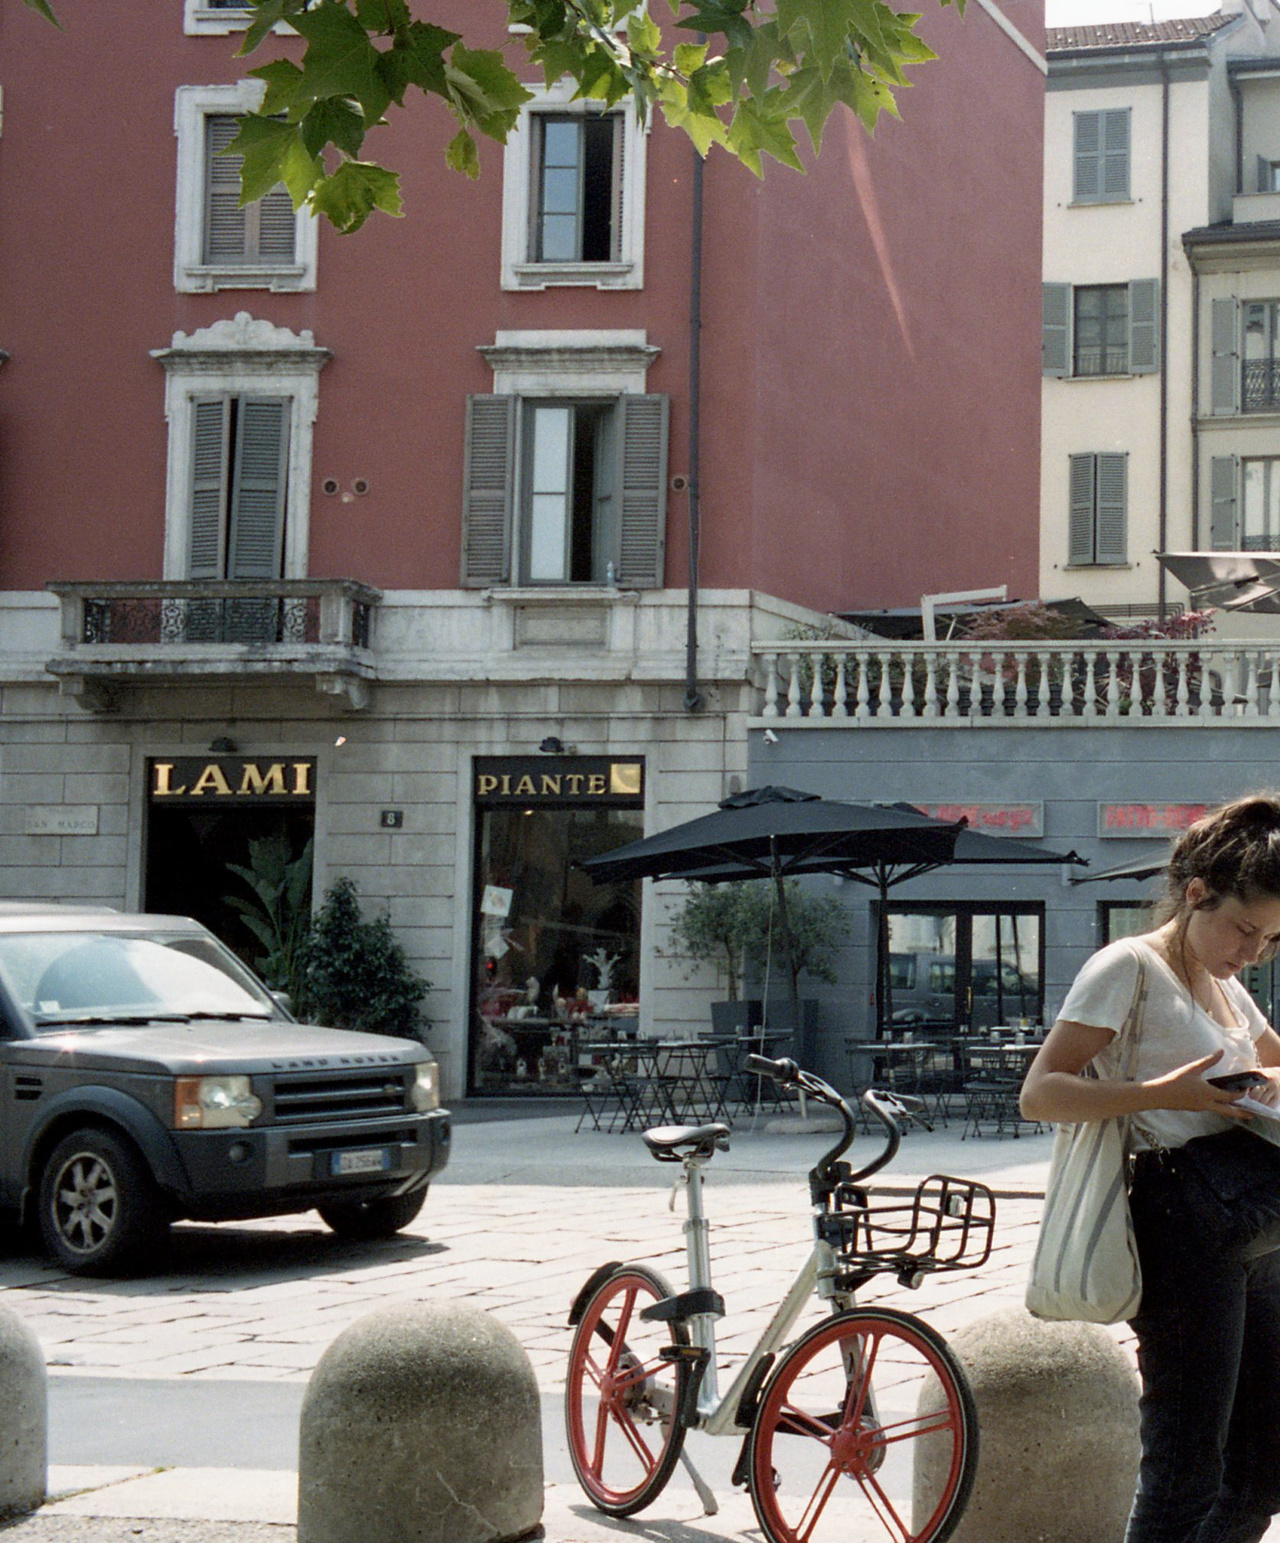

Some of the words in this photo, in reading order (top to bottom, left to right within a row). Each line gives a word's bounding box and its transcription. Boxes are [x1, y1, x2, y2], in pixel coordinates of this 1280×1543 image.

[153, 763, 311, 795] LAMI
[477, 774, 608, 795] PIANTE
[386, 812, 396, 825] 8
